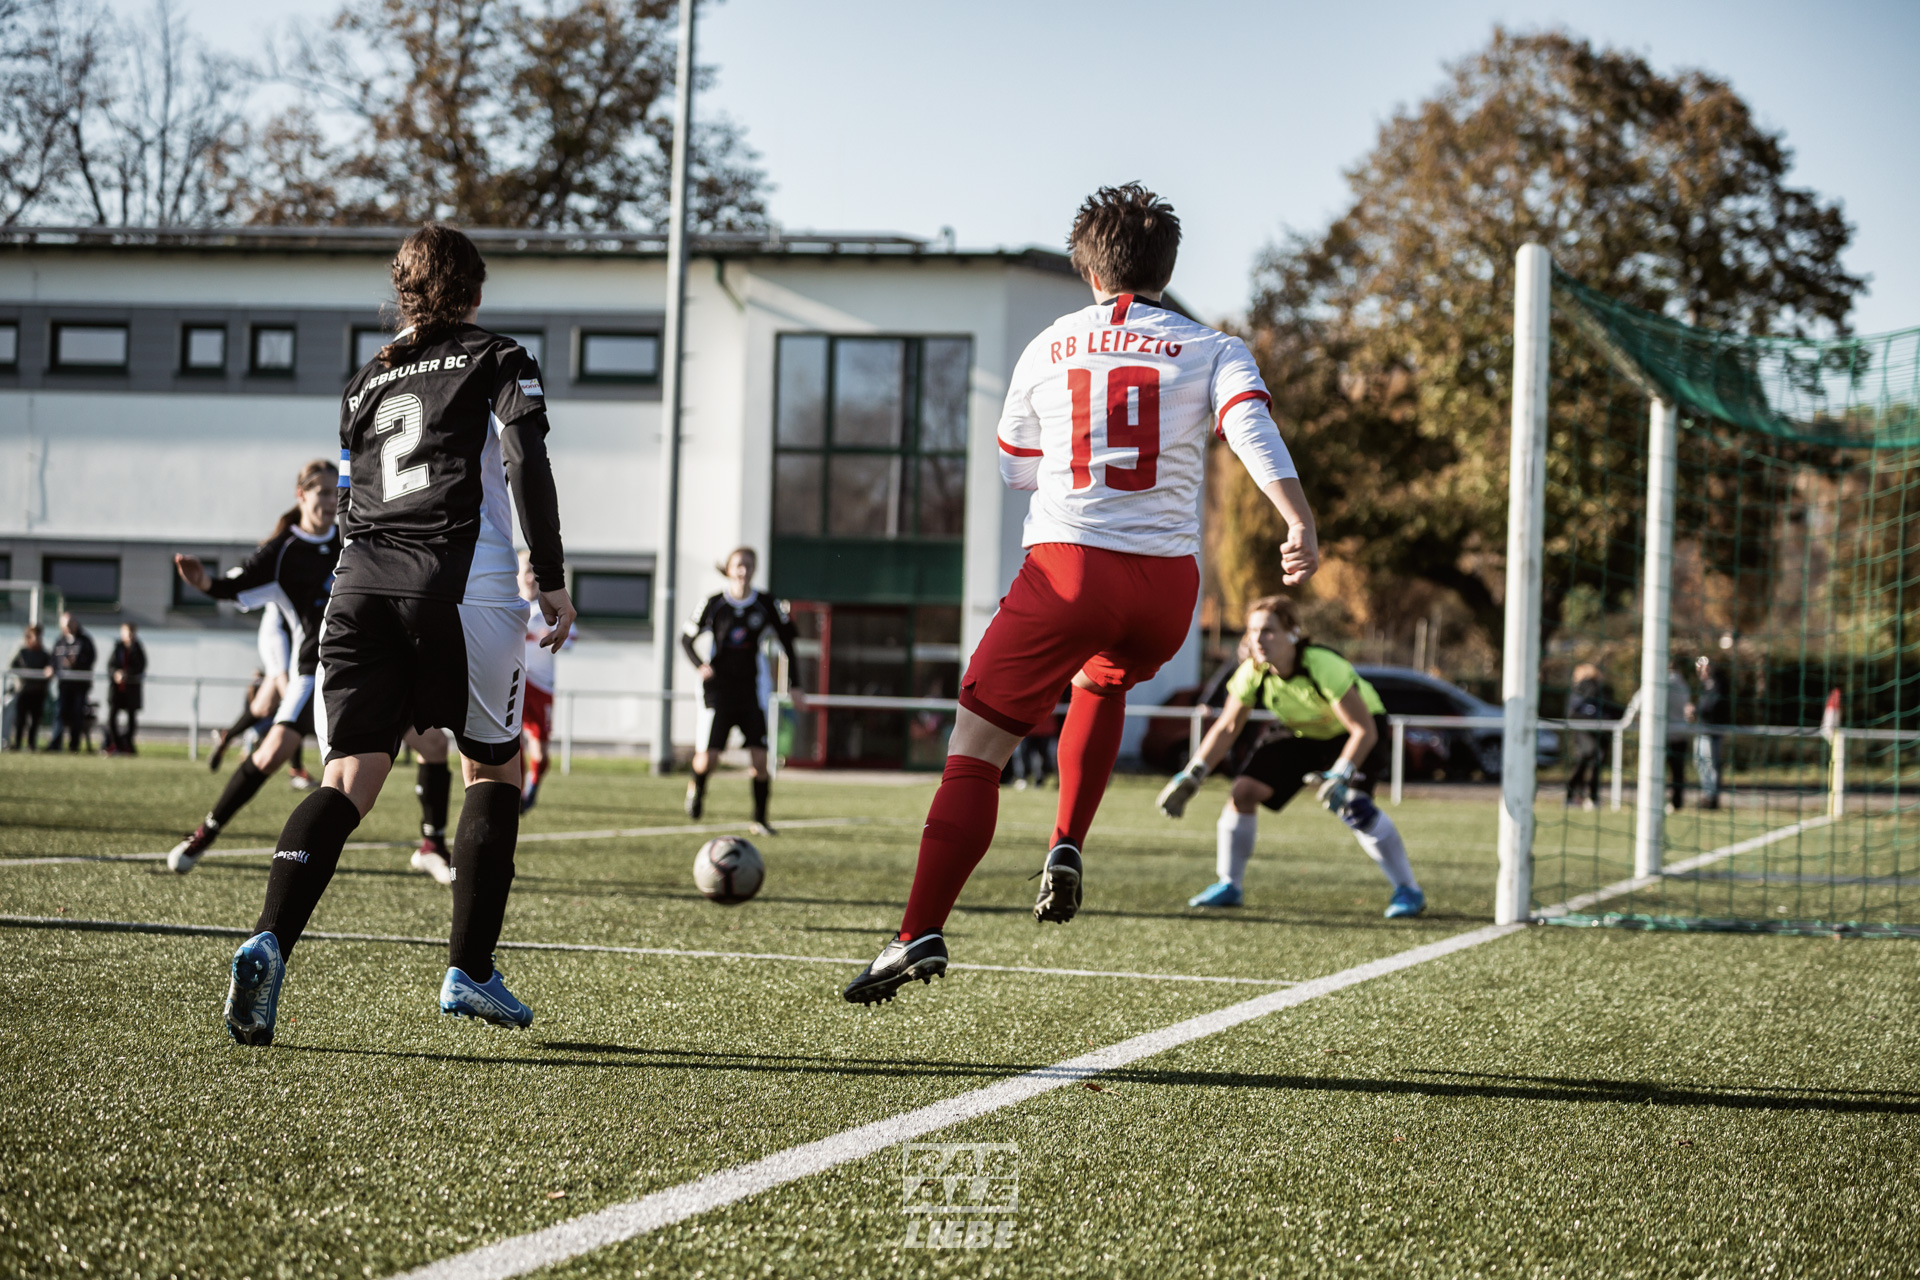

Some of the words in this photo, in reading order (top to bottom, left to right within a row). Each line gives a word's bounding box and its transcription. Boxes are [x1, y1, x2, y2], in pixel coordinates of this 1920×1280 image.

[444, 355, 467, 370] BC
[1051, 336, 1077, 364] RB
[1088, 330, 1182, 358] LEIPZIG
[375, 393, 430, 503] 2
[1067, 366, 1160, 491] 19
